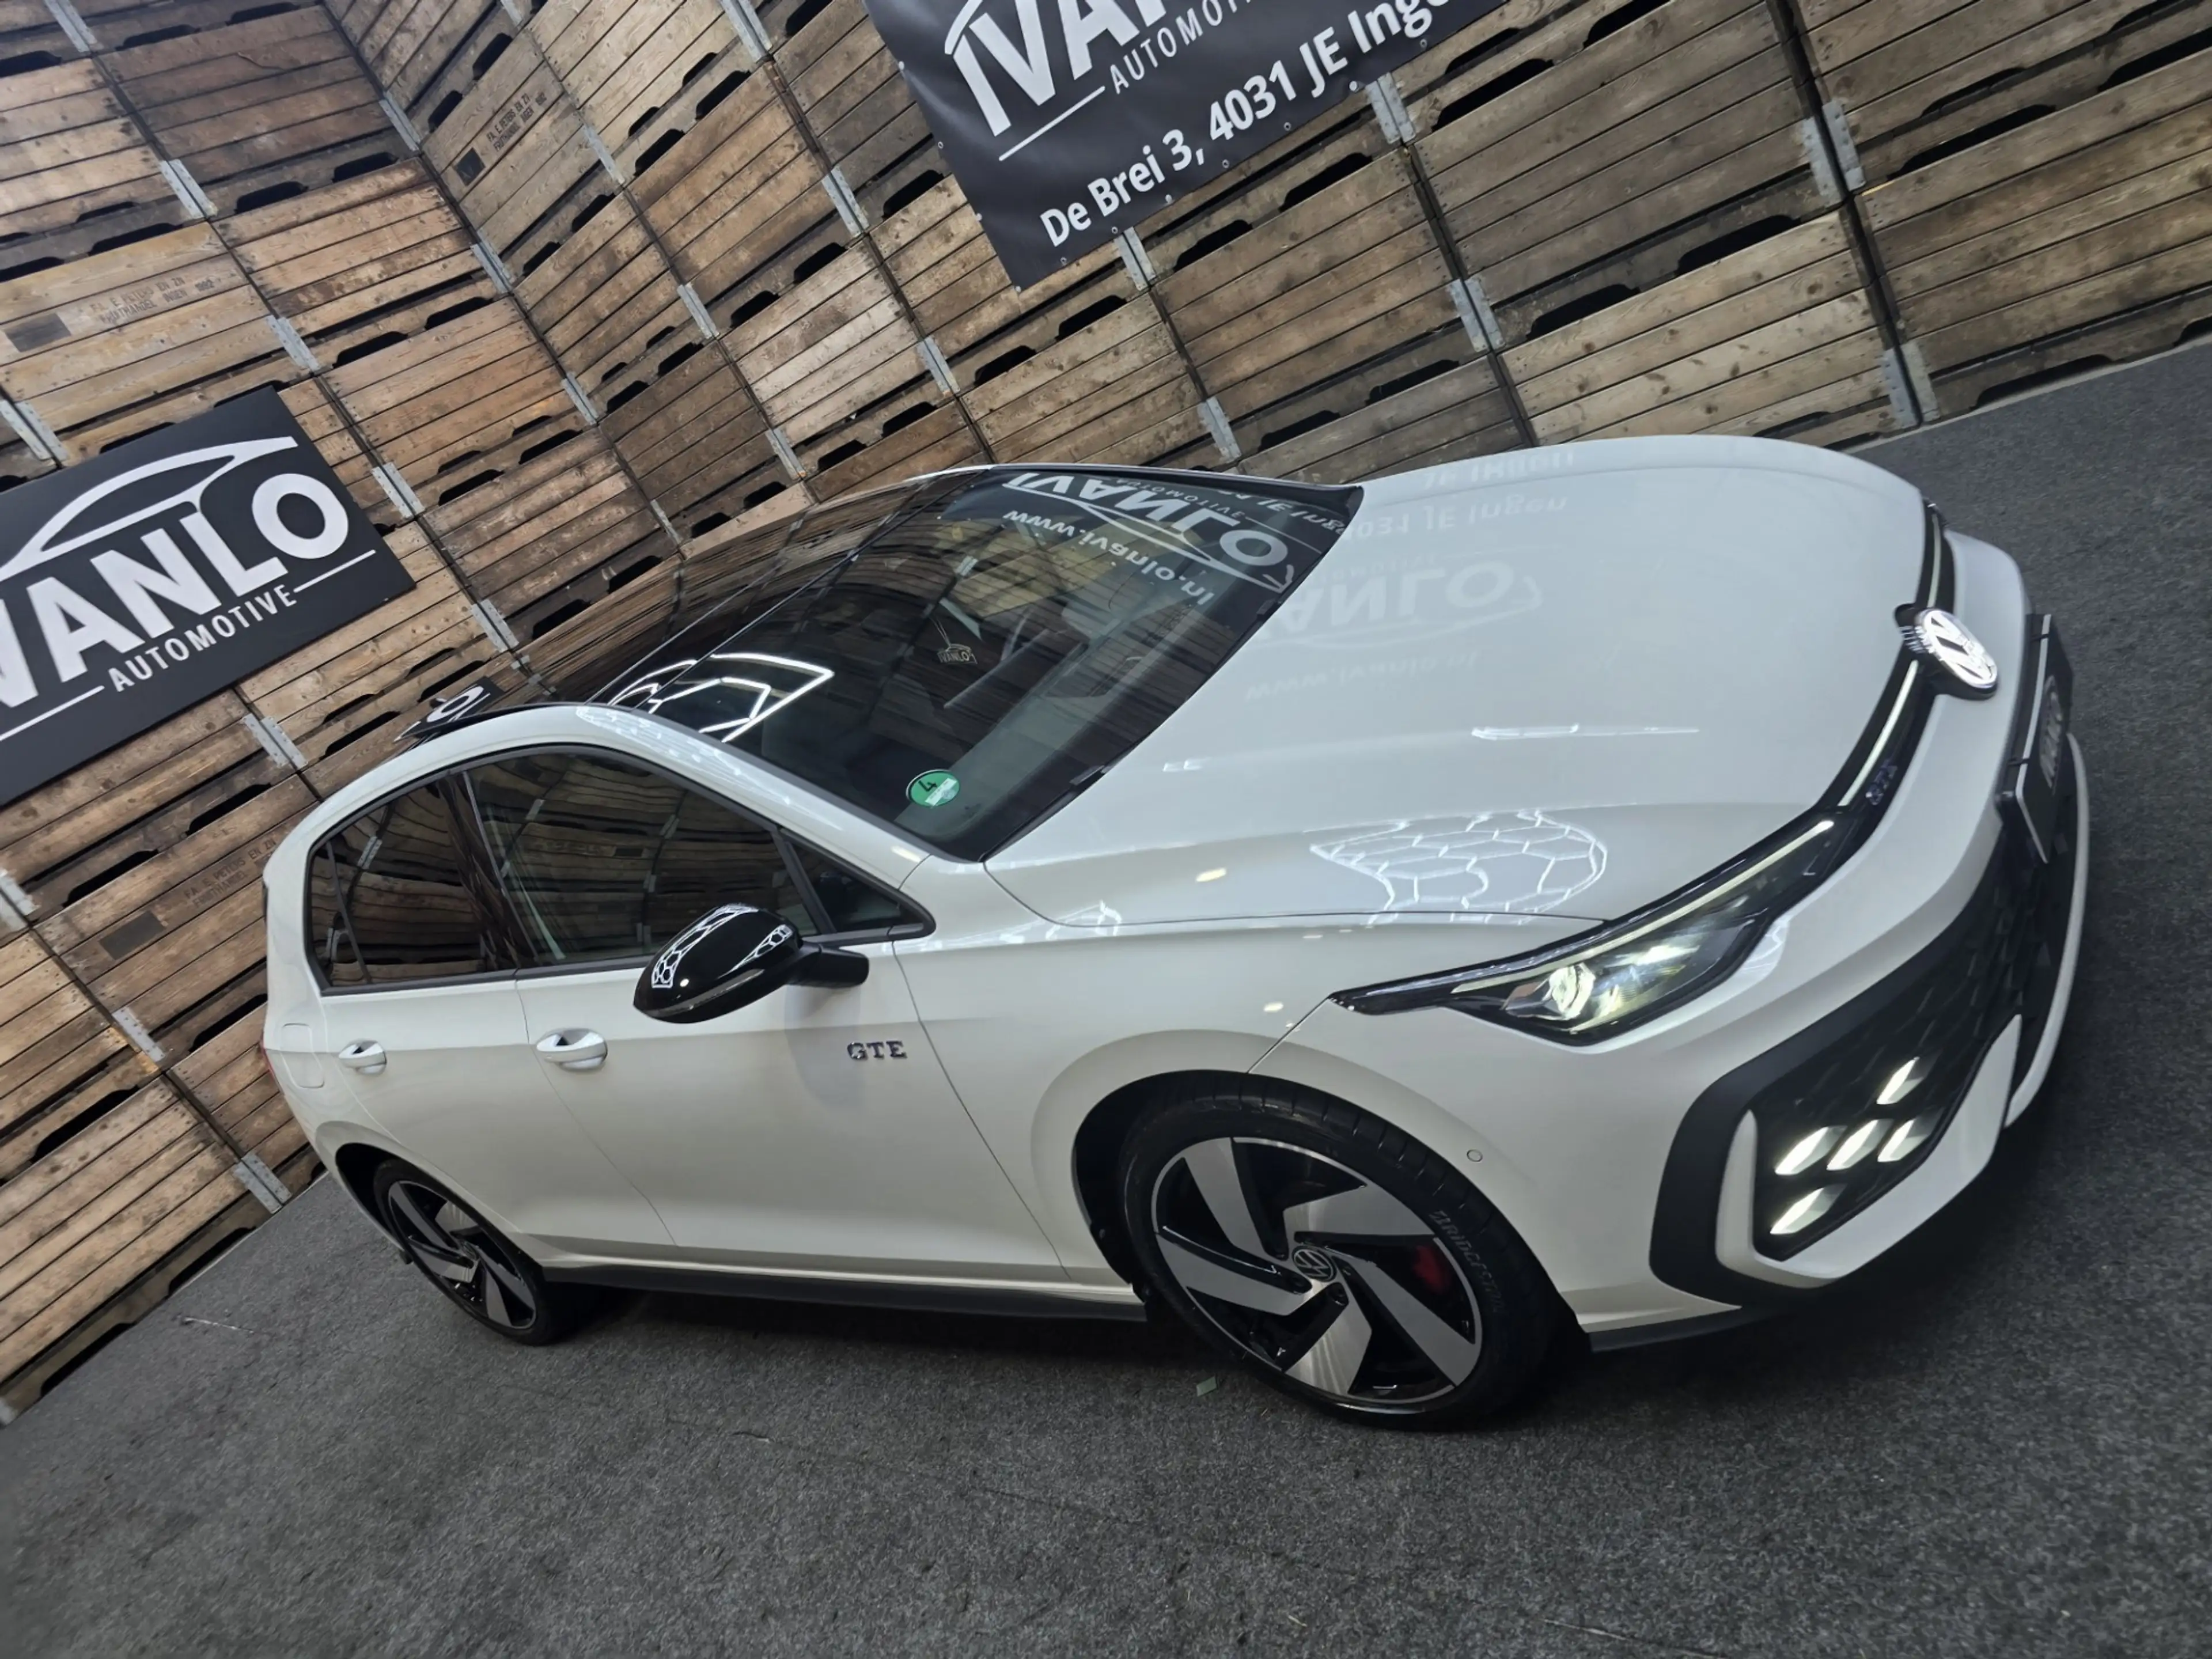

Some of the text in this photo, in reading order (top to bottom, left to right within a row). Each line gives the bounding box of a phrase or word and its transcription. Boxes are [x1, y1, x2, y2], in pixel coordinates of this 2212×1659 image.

[953, 0, 1166, 137] IVA
[1040, 202, 1092, 247] De
[1088, 145, 1165, 217] Brei
[1162, 129, 1205, 171] 3,
[1210, 60, 1297, 141] 4031
[1299, 26, 1349, 98] JE
[108, 584, 297, 692] AUTOMOTIVE
[847, 1040, 908, 1060] GTE
